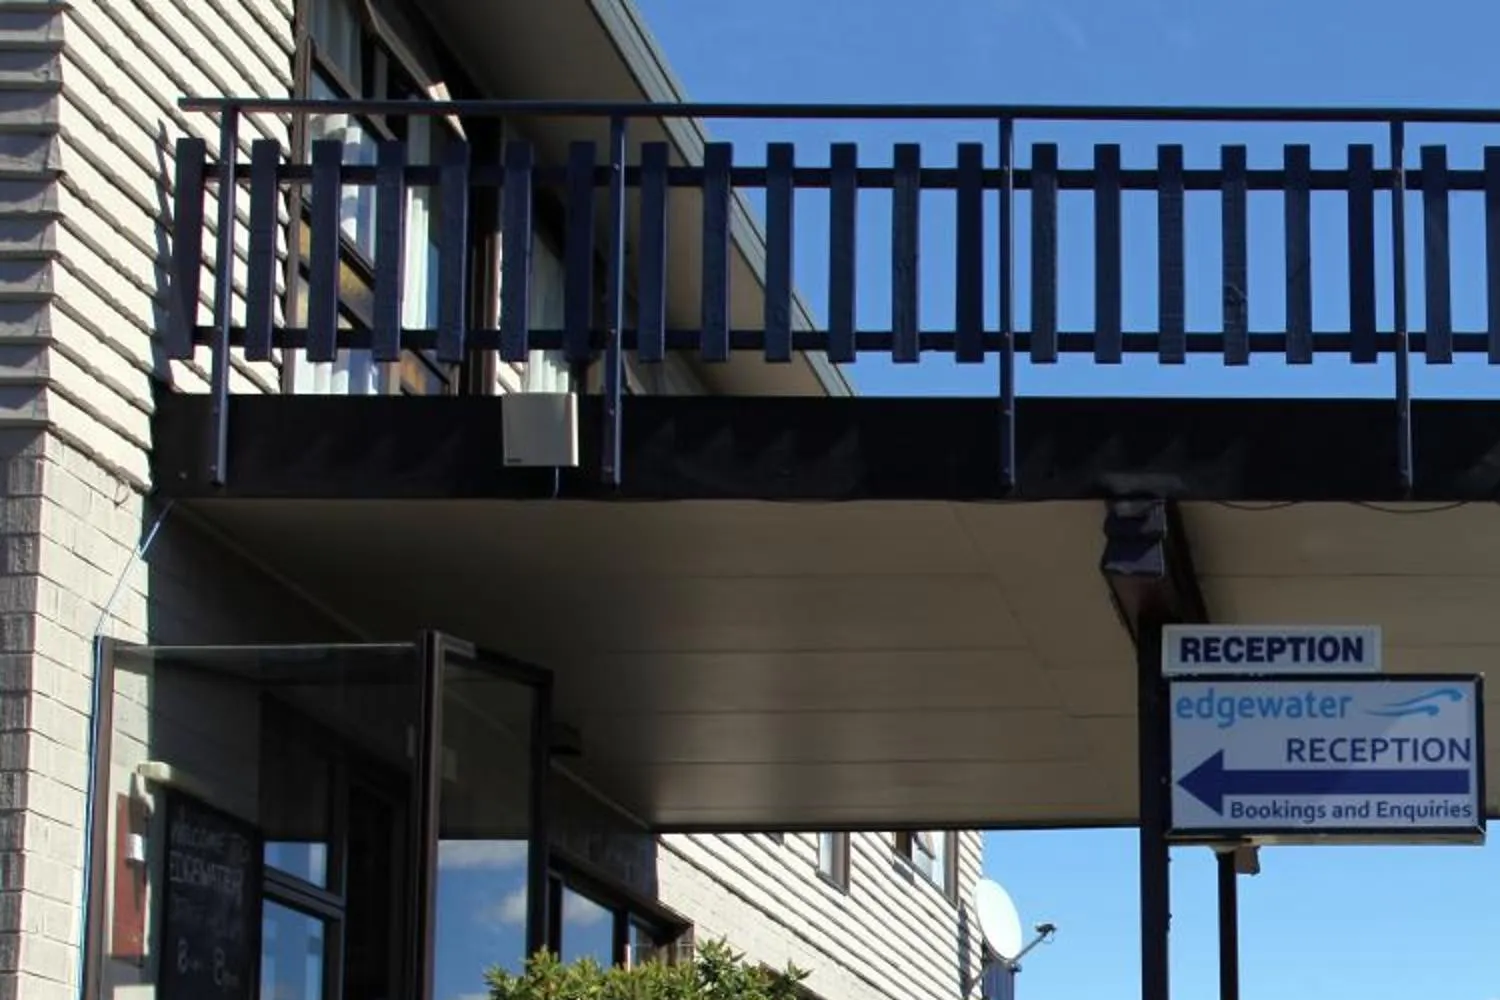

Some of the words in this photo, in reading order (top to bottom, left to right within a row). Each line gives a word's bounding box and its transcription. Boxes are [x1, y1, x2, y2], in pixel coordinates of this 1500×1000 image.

[1180, 636, 1364, 663] RECEPTION
[1175, 687, 1353, 728] edgewater
[1286, 737, 1471, 763] RECEPTION
[1230, 800, 1326, 823] Bookings
[1332, 800, 1369, 818] and
[1376, 800, 1472, 822] Enquiries
